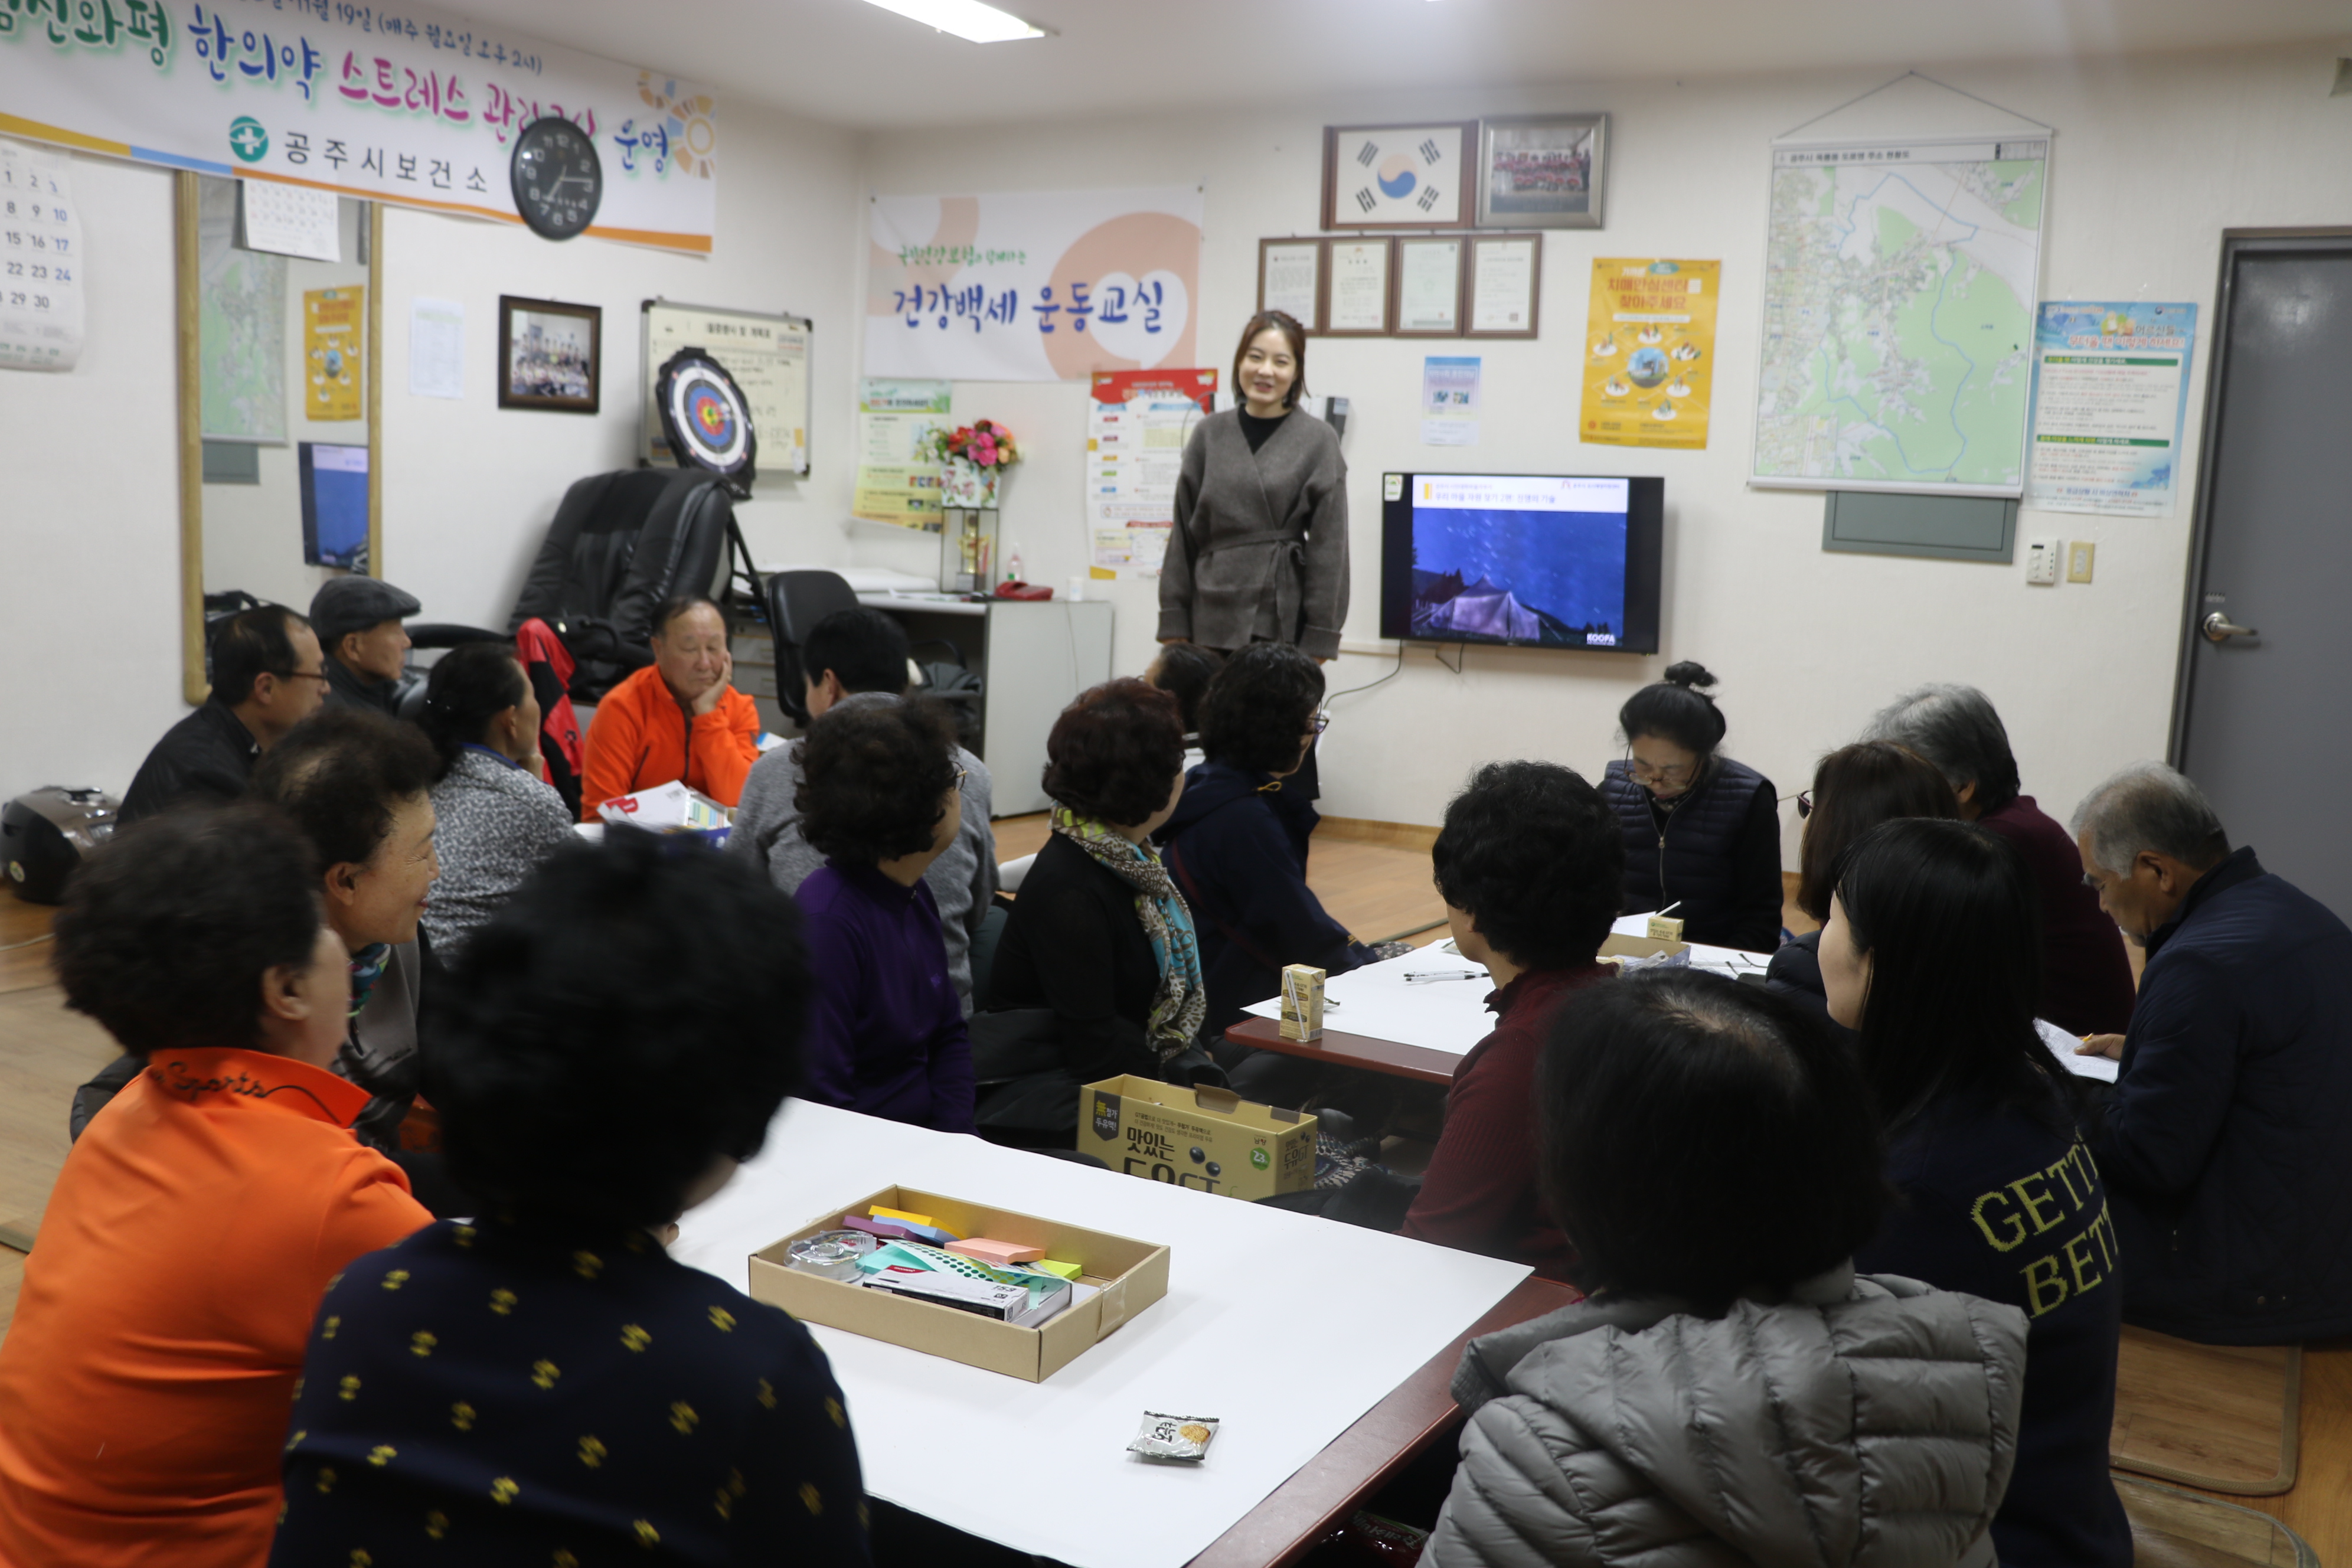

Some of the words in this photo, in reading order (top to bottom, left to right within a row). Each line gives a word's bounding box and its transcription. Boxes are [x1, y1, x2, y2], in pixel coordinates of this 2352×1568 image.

[425, 24, 472, 57] 월요일
[476, 40, 508, 64] 오후
[188, 2, 322, 100] 한의약
[338, 50, 470, 122] 스트레스
[614, 119, 669, 173] 운영
[5, 231, 22, 245] 15
[30, 234, 46, 249] 16
[54, 238, 70, 251] 17
[6, 262, 24, 276] 22
[31, 265, 48, 279] 23
[54, 267, 72, 282] 24
[34, 295, 50, 309] 30
[893, 283, 1018, 334] 건강백세
[1032, 280, 1163, 334] 운동교실
[2135, 325, 2176, 336] 어르신들
[1126, 1126, 1175, 1162] 맛있는
